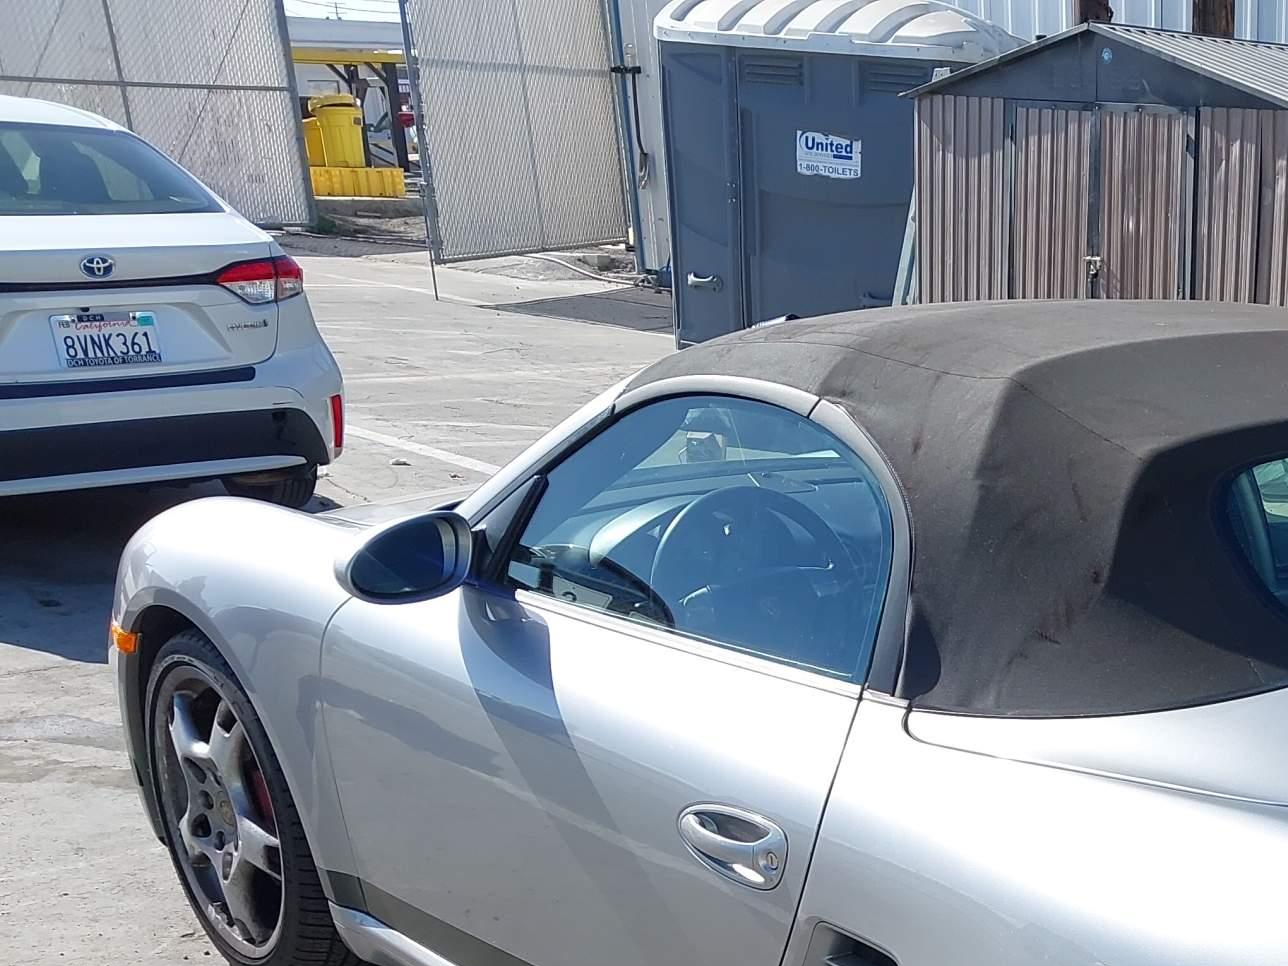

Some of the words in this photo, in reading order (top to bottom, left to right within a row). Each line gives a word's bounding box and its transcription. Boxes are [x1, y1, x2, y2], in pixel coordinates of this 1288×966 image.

[805, 135, 853, 154] United
[799, 163, 859, 177] 1-800-TOILETS
[75, 320, 137, 332] California
[63, 331, 156, 359] 8VNK361
[85, 357, 113, 366] TOYOTA
[114, 356, 123, 364] OF
